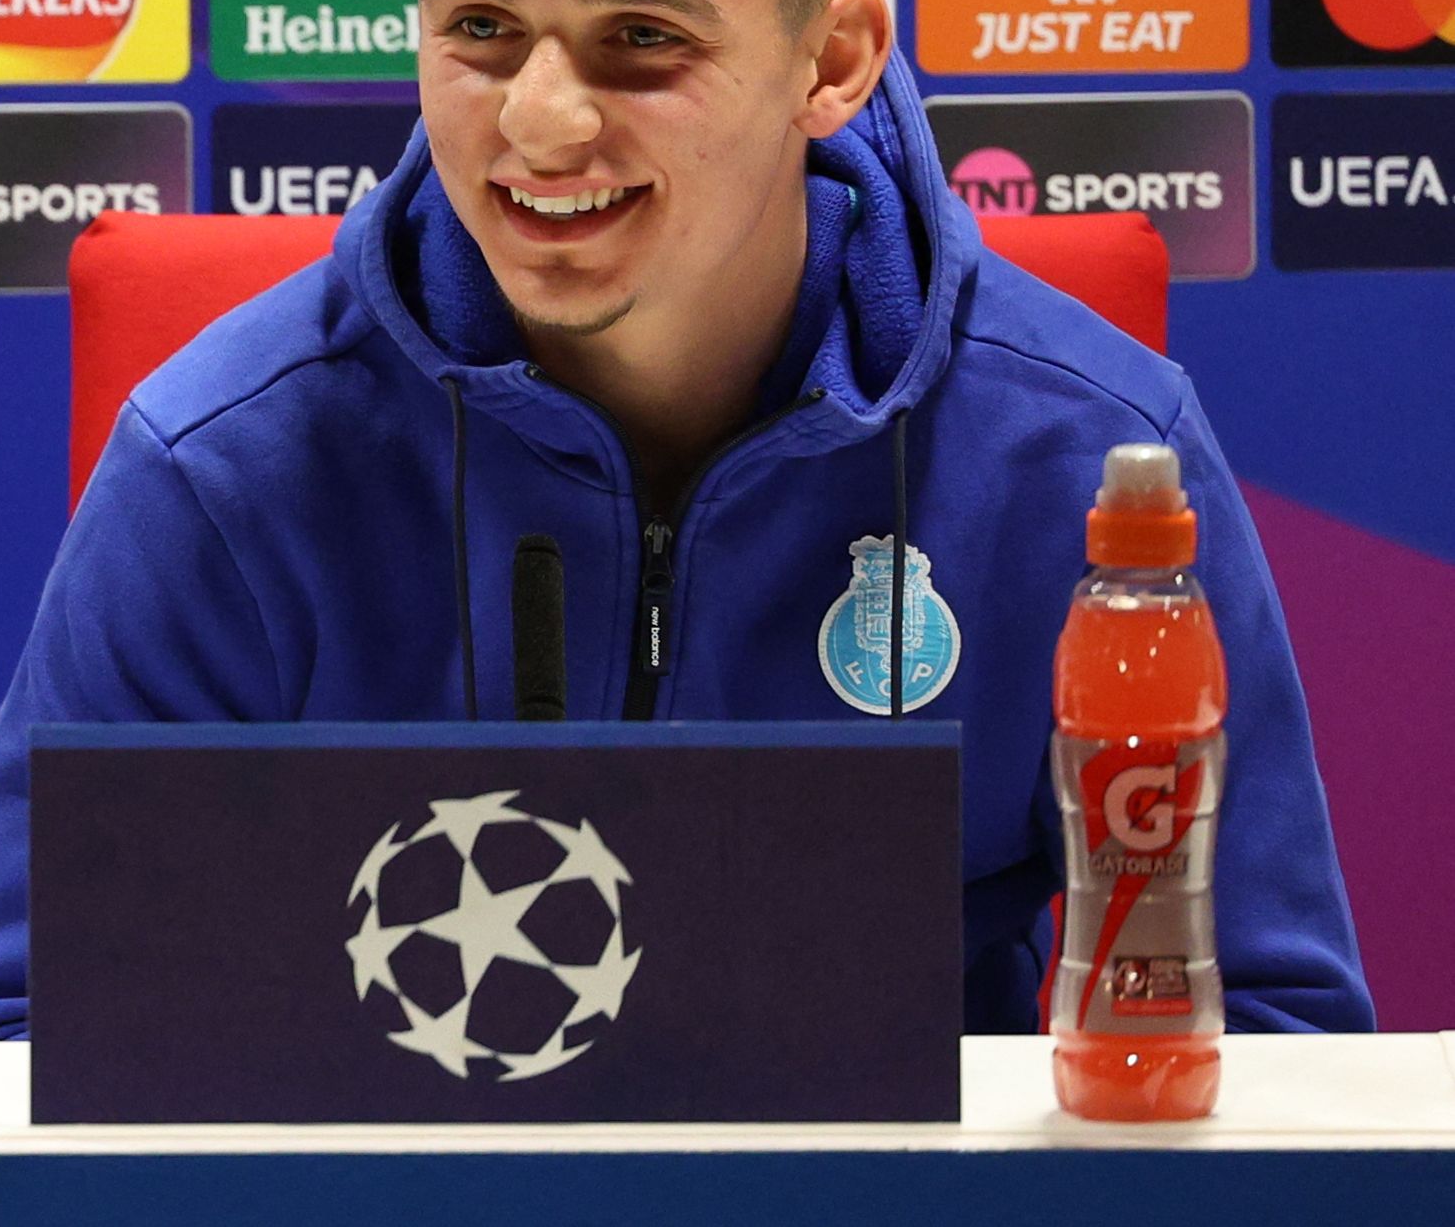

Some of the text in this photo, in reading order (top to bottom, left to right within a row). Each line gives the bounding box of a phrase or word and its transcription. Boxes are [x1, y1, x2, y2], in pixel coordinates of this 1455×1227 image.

[244, 3, 420, 55] Heine
[972, 11, 1194, 59] JUST EAT
[228, 165, 380, 215] UEFA
[1045, 172, 1223, 212] SPORTS
[1290, 156, 1448, 207] UEFA
[651, 606, 661, 667] new balance
